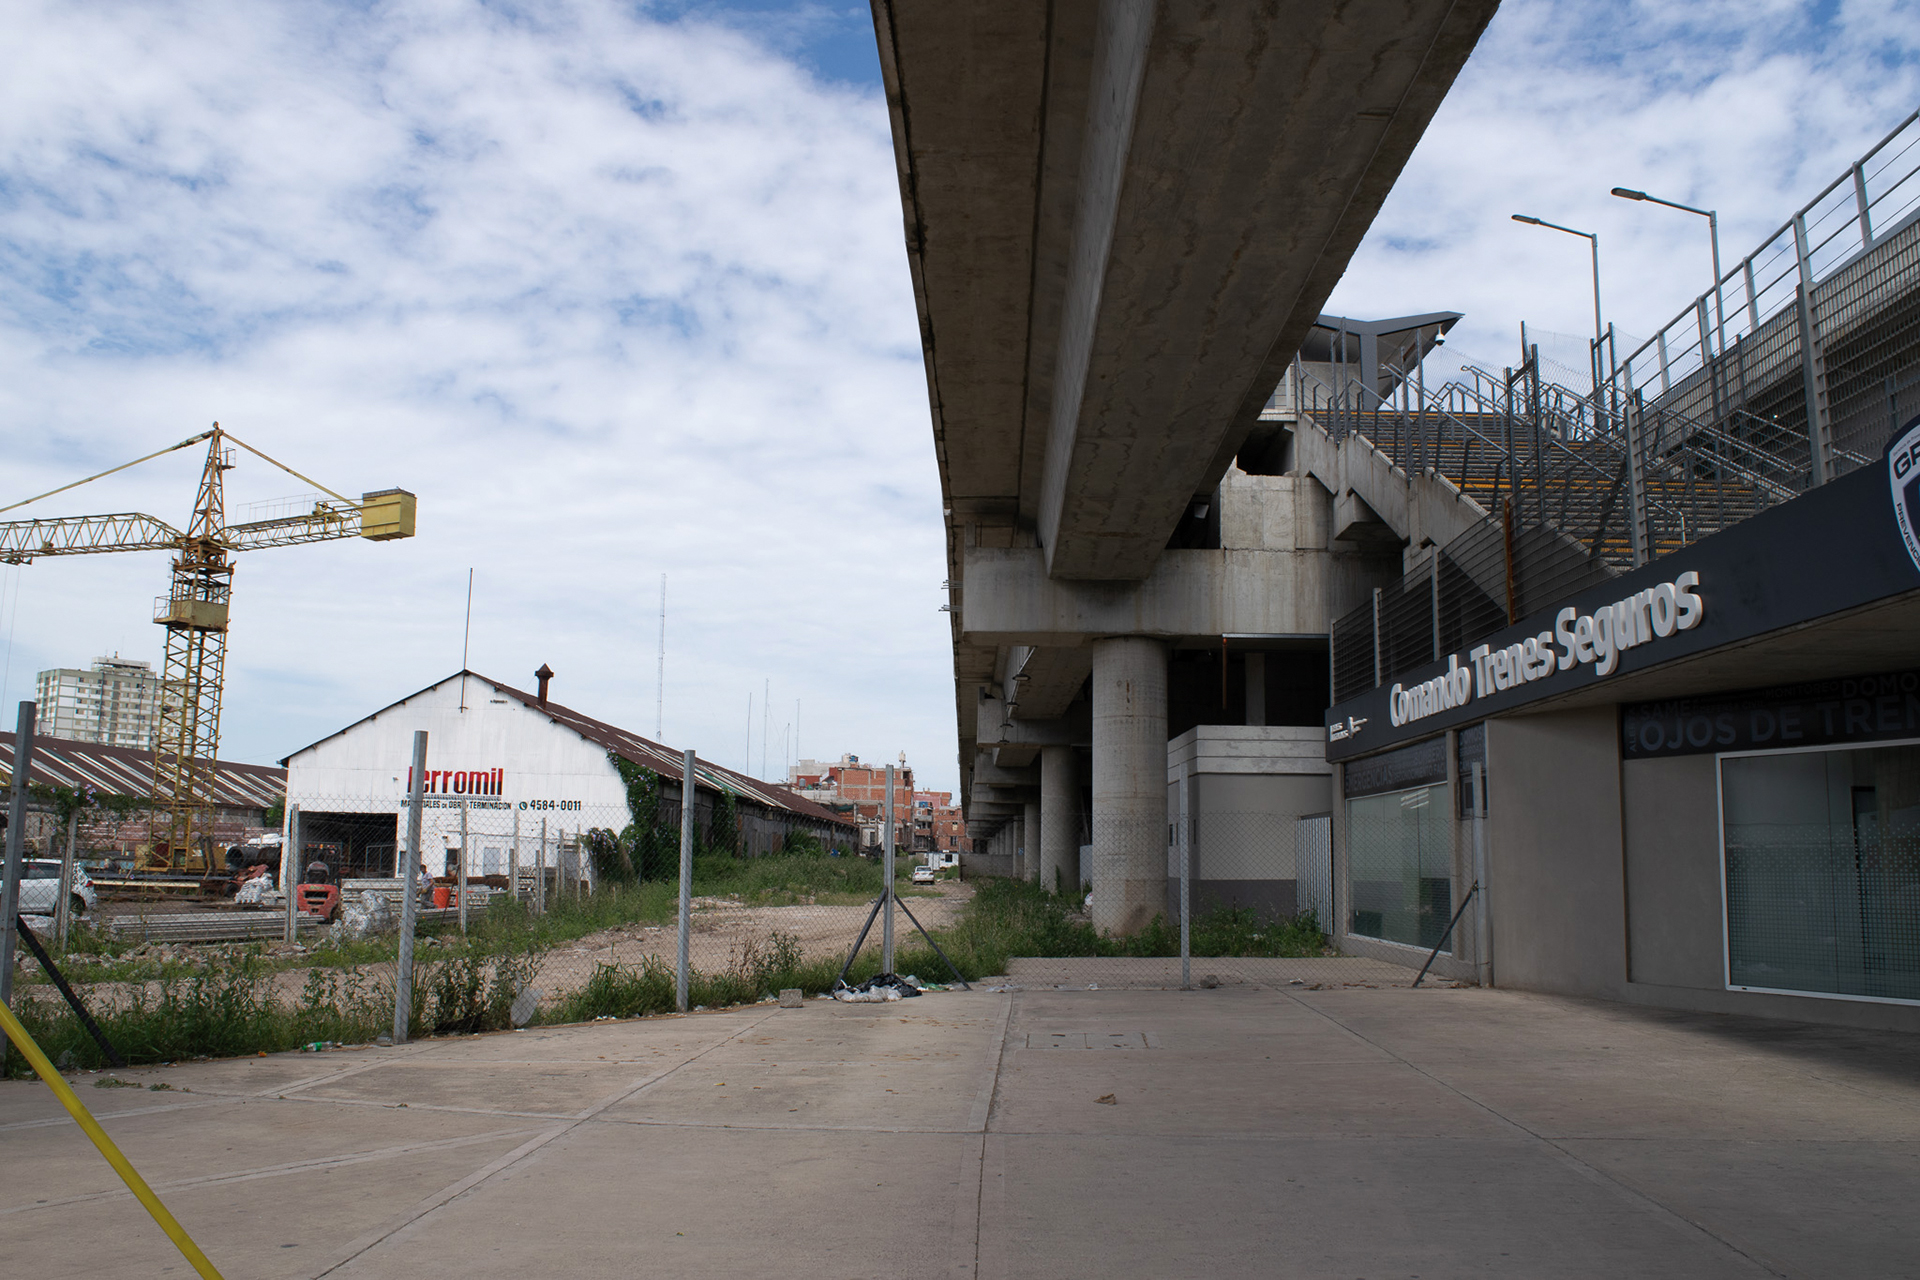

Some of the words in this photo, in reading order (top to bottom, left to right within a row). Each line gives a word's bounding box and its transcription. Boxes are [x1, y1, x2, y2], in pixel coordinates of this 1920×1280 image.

[1390, 654, 1471, 727] Comando
[1470, 631, 1555, 698] Trenes
[1556, 571, 1703, 676] Seguros
[1639, 700, 1692, 720] SAME
[1640, 712, 1736, 751] OJOS
[1750, 703, 1803, 742] DE
[407, 766, 503, 795] erromil
[1346, 765, 1393, 792] EMERGENCIAS
[529, 799, 582, 811] 4584-0011
